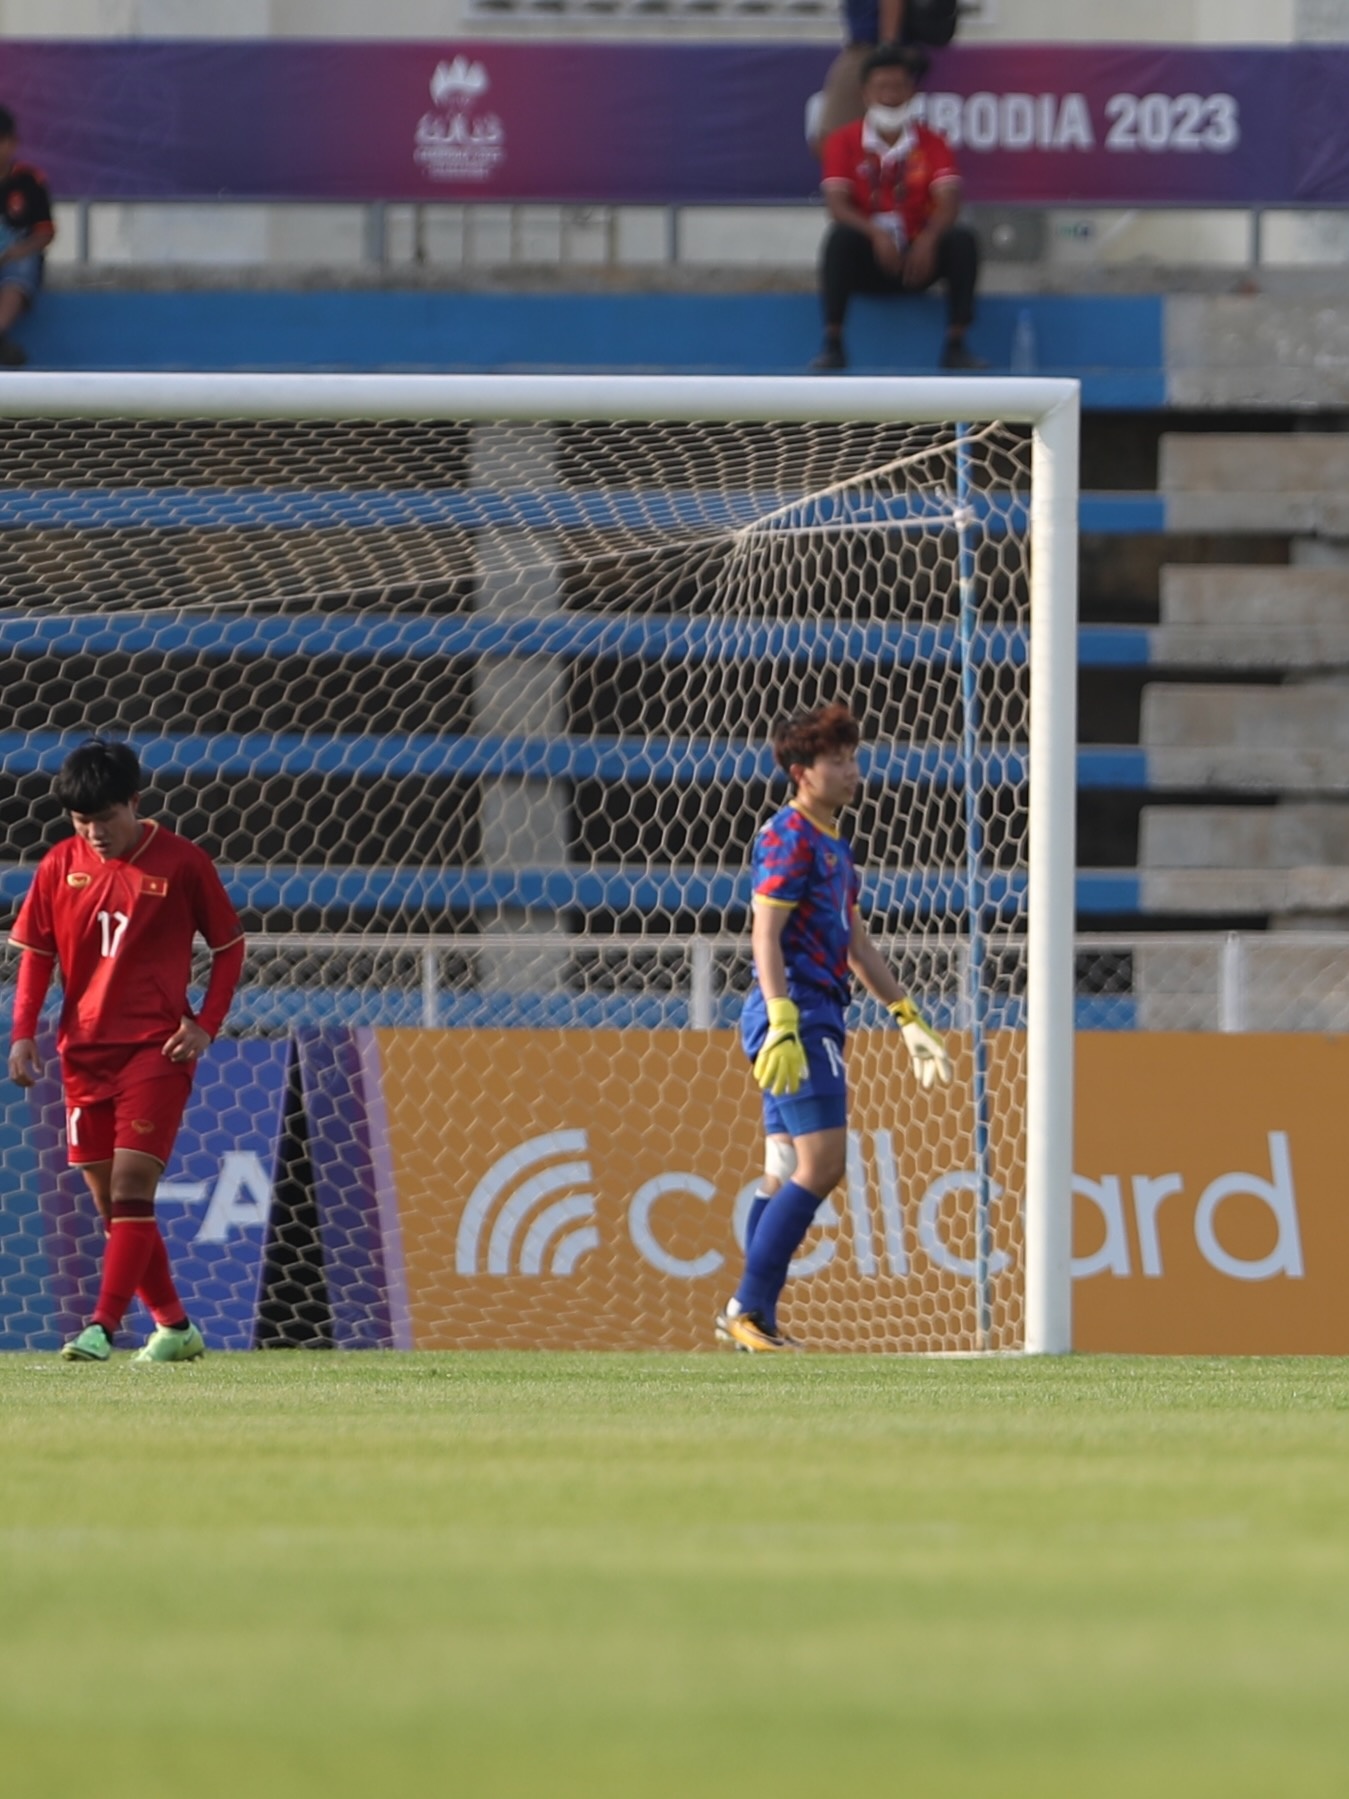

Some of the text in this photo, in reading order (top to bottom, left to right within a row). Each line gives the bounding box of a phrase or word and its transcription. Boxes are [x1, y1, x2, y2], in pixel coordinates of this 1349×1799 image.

[805, 91, 1239, 153] BODIA 2023
[97, 910, 129, 959] 17
